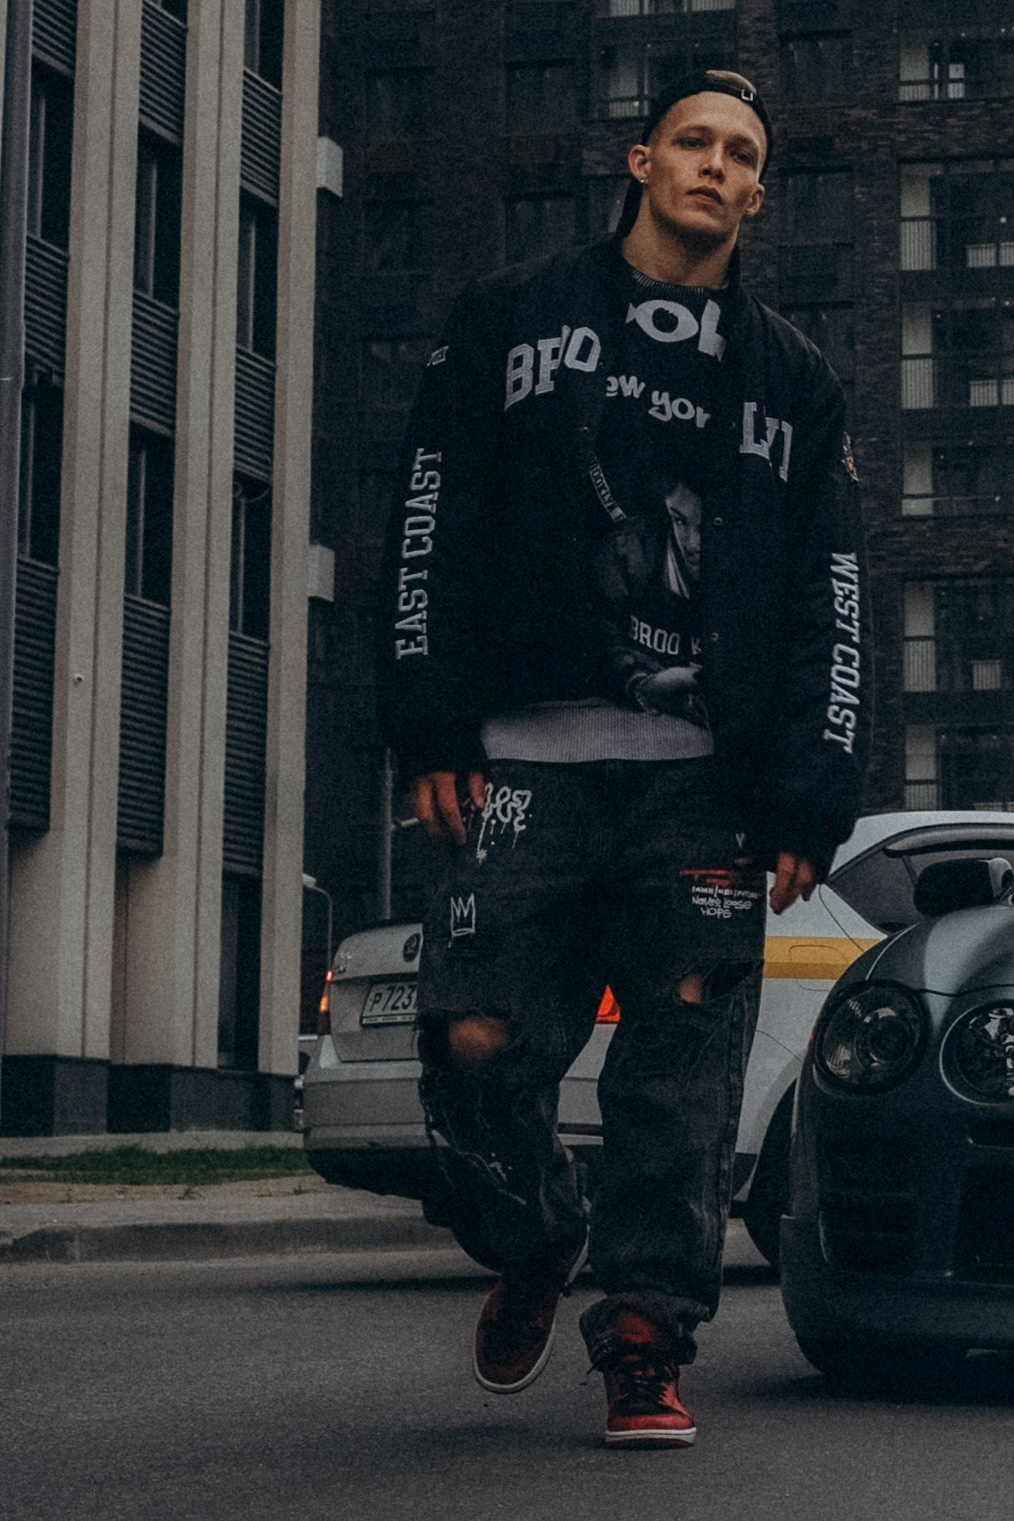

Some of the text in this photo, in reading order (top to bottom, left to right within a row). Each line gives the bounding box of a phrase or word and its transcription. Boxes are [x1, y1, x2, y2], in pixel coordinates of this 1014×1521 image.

[395, 447, 442, 660] EAST COAST
[823, 552, 861, 755] WEST COAST
[369, 985, 417, 1012] P723
